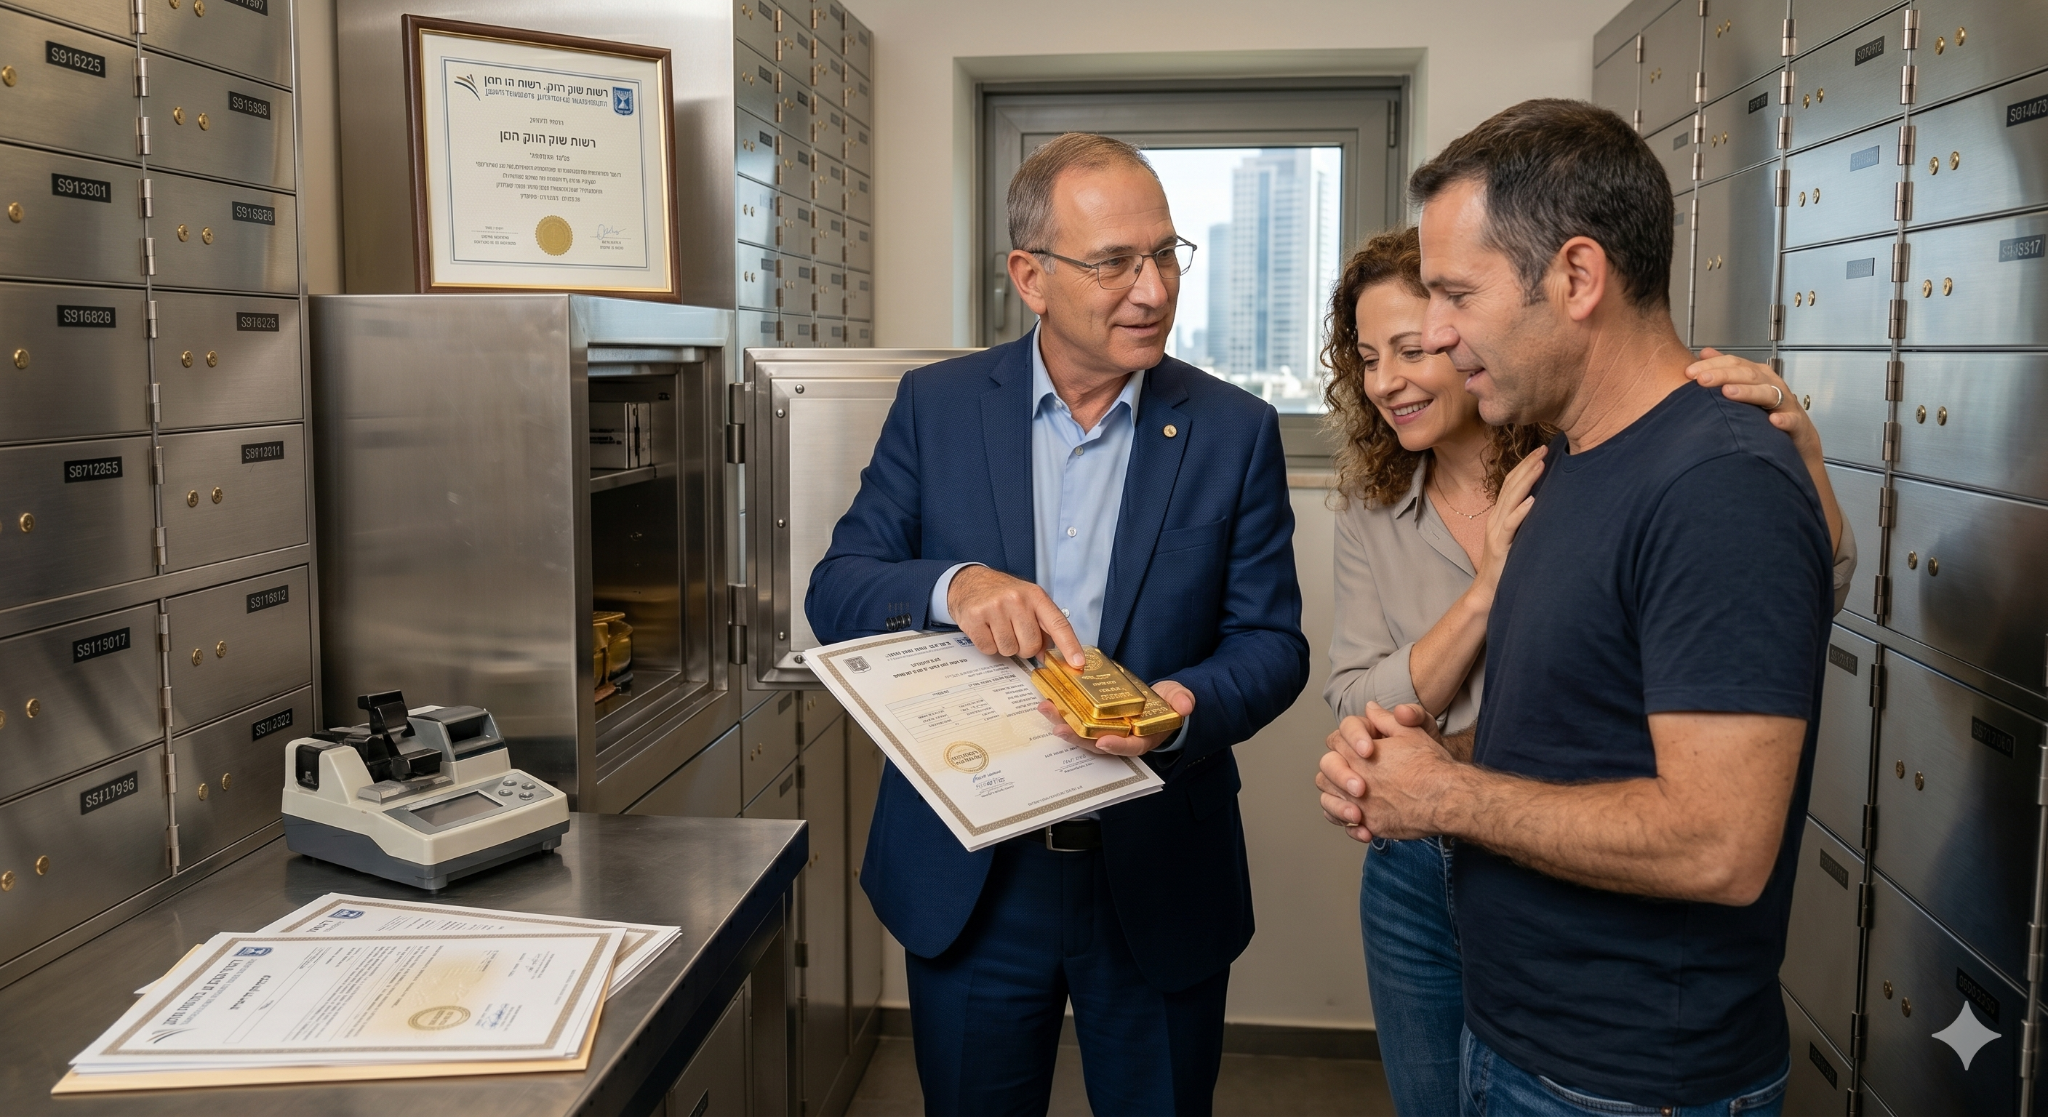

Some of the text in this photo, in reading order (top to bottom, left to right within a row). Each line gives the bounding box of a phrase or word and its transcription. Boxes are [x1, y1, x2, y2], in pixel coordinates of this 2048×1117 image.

[51, 47, 101, 72] S916225
[567, 85, 584, 96] שוק
[586, 87, 609, 98] רשות
[548, 135, 568, 147] שוק
[570, 137, 596, 148] רשות
[57, 178, 106, 198] S913301
[64, 309, 111, 324] S916828
